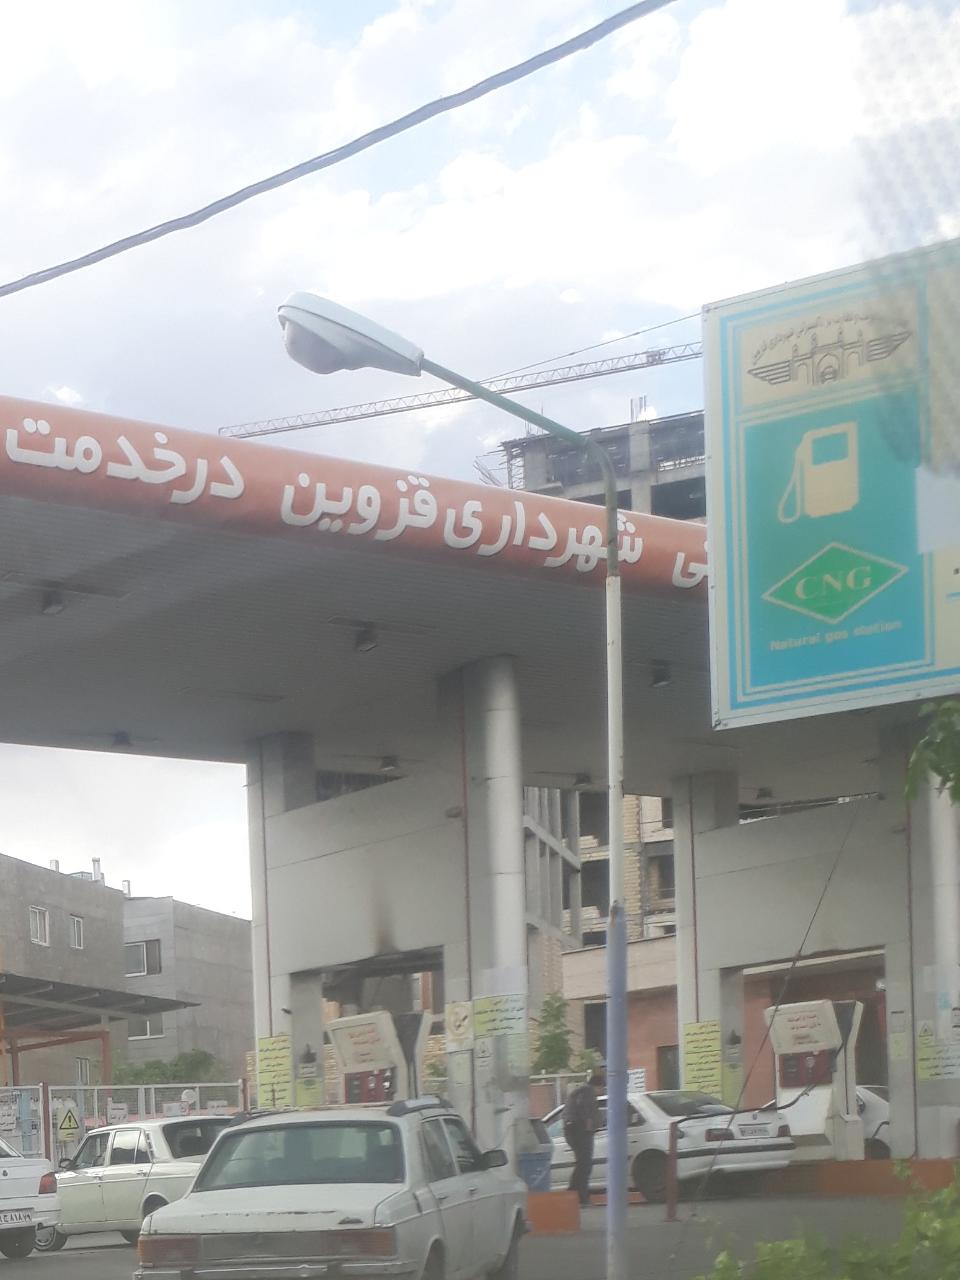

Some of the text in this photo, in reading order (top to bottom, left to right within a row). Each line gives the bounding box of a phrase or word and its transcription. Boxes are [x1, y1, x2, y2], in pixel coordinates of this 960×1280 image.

[279, 474, 438, 542] قزوین
[795, 566, 872, 600] CNG
[825, 630, 848, 644] gas
